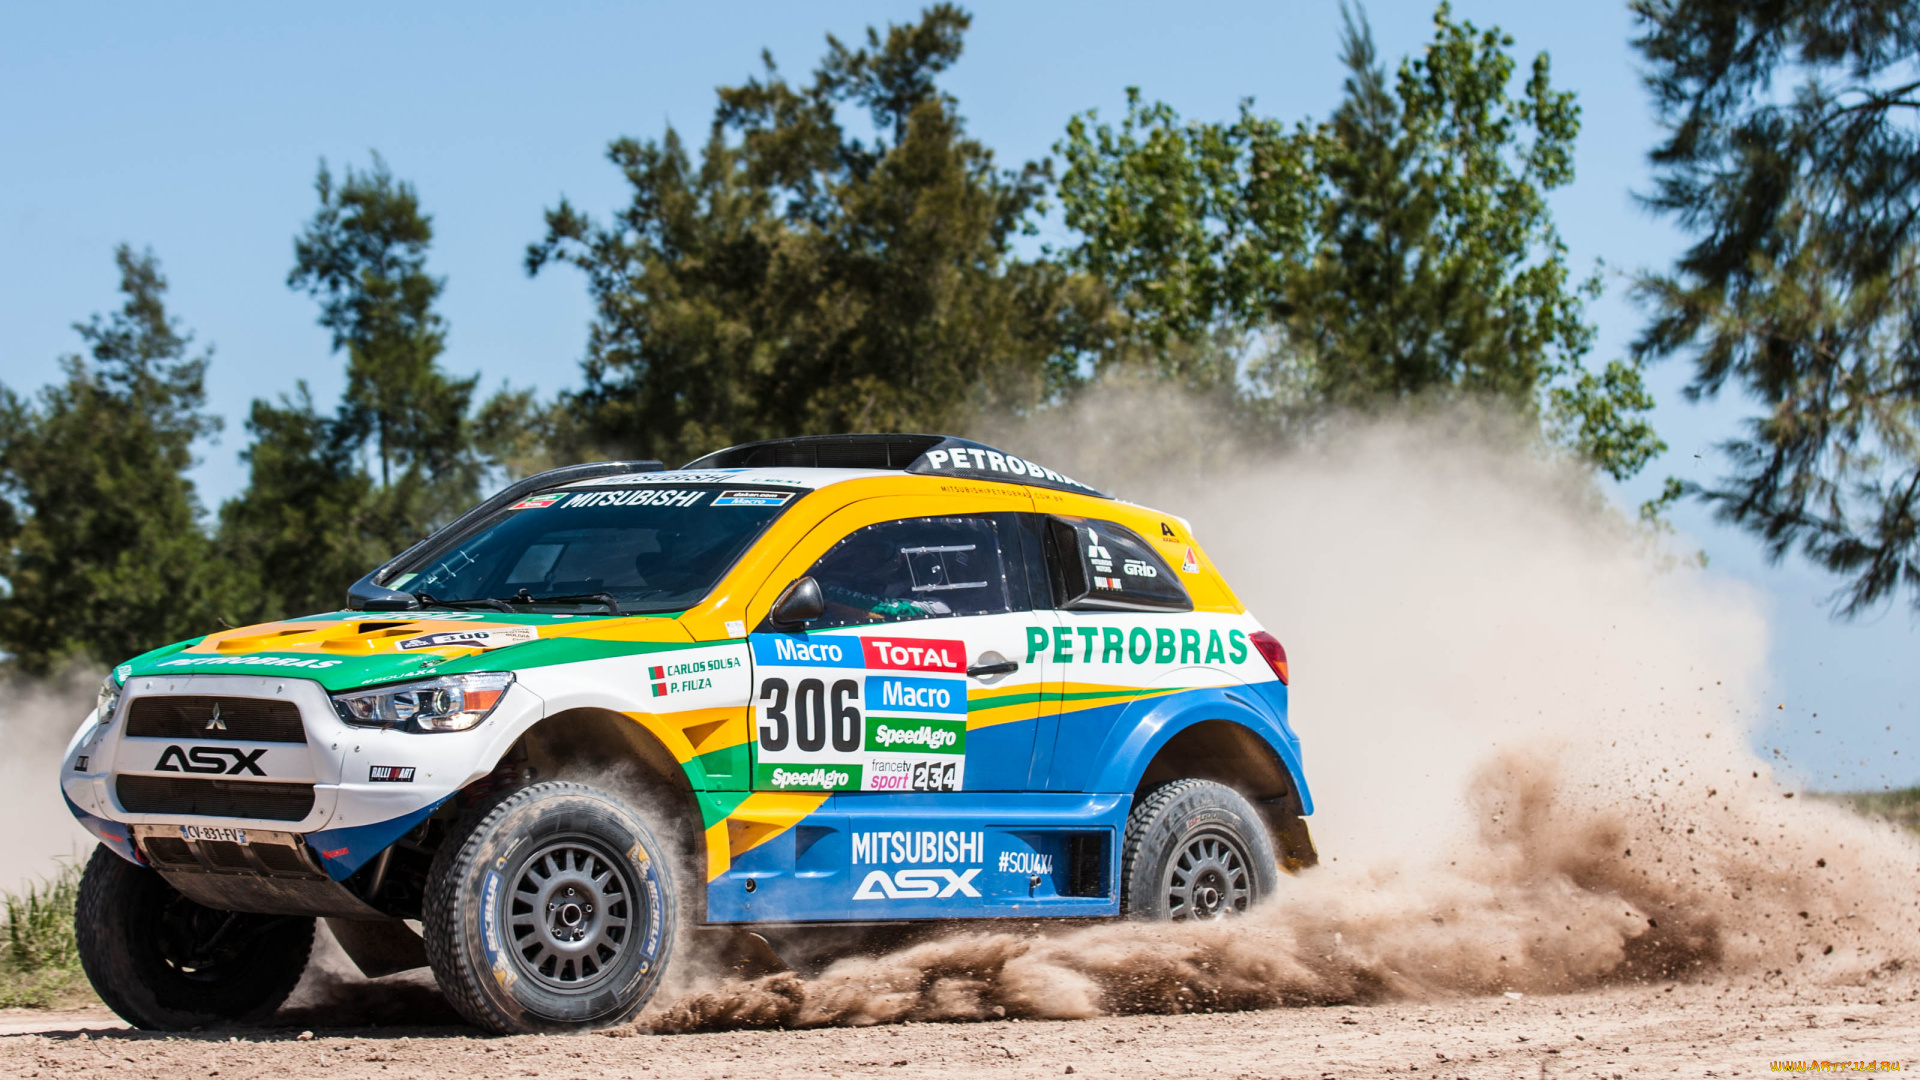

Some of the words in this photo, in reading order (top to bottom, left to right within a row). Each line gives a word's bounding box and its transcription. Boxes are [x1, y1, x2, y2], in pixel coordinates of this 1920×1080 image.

[560, 490, 706, 509] MITSUBISHI
[442, 632, 490, 641] 306
[1025, 626, 1248, 665] PETROBRAS
[775, 638, 843, 662] Macro
[871, 641, 958, 668] TOTAL
[667, 661, 706, 676] CARLOS
[707, 657, 741, 671] SOUSA
[670, 682, 680, 693] P.
[682, 678, 712, 692] FIUZA
[882, 680, 951, 708] Macro
[759, 677, 861, 752] 306
[875, 724, 957, 749] SpeedAgro
[154, 744, 269, 777] ASX
[871, 759, 912, 772] francetv
[771, 767, 849, 788] SpeedAgro
[870, 772, 909, 791] sport
[187, 825, 238, 841] CV-831-FV
[851, 831, 984, 864] MITSUBISHI
[998, 851, 1053, 875] #SOU4X4
[852, 868, 983, 900] ASX
[647, 879, 661, 956] MICHELIN
